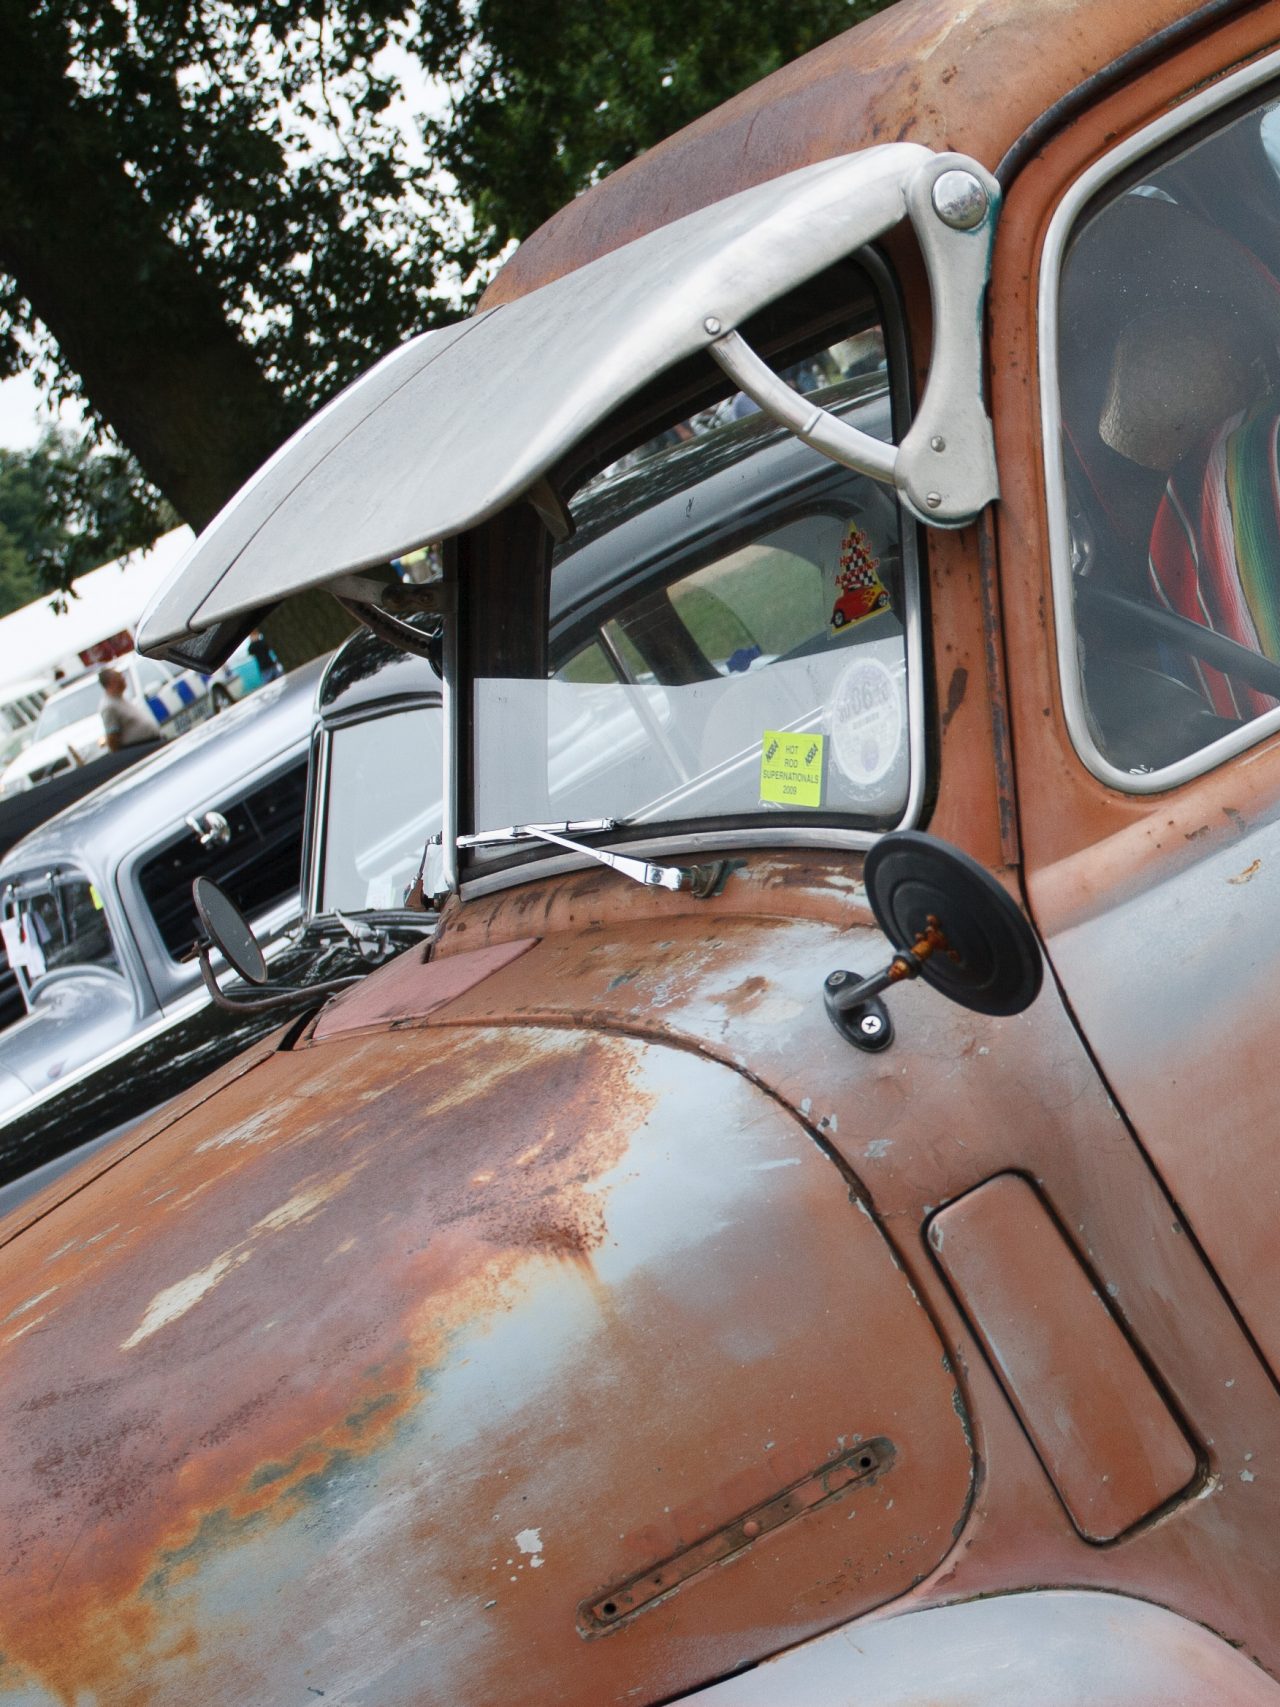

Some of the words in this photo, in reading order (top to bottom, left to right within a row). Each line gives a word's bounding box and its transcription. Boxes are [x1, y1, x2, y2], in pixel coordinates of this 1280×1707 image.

[785, 745, 799, 755] HOT
[784, 758, 799, 768] ROD
[763, 769, 819, 784] SUPERNATIONALS
[783, 785, 797, 795] 2009
